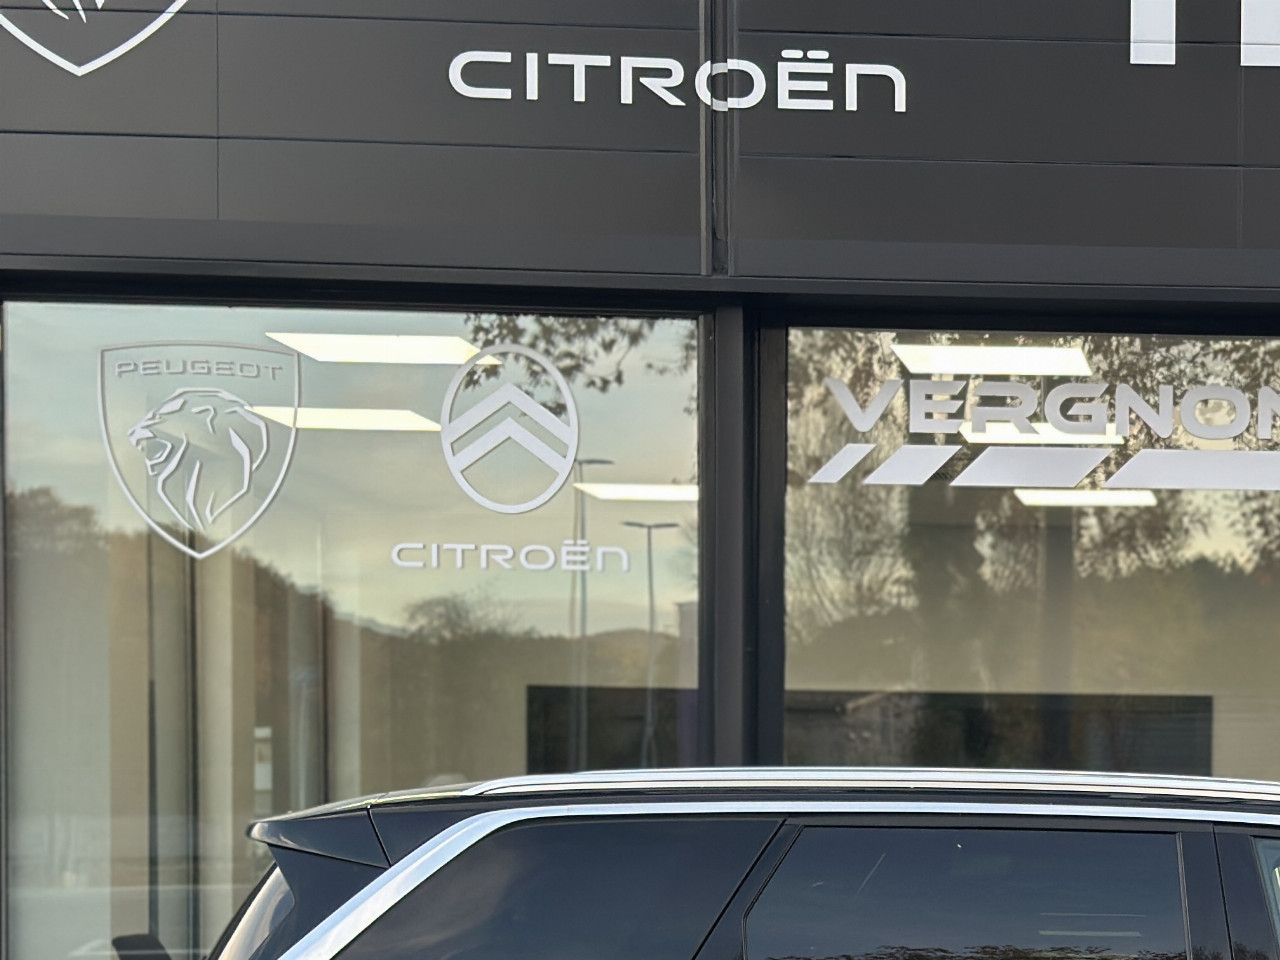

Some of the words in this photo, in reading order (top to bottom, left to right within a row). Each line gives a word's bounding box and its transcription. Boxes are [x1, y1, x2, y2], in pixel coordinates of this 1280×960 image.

[448, 49, 907, 113] CITROËN
[115, 359, 283, 381] PEUGEOT
[391, 539, 631, 572] CITROËN
